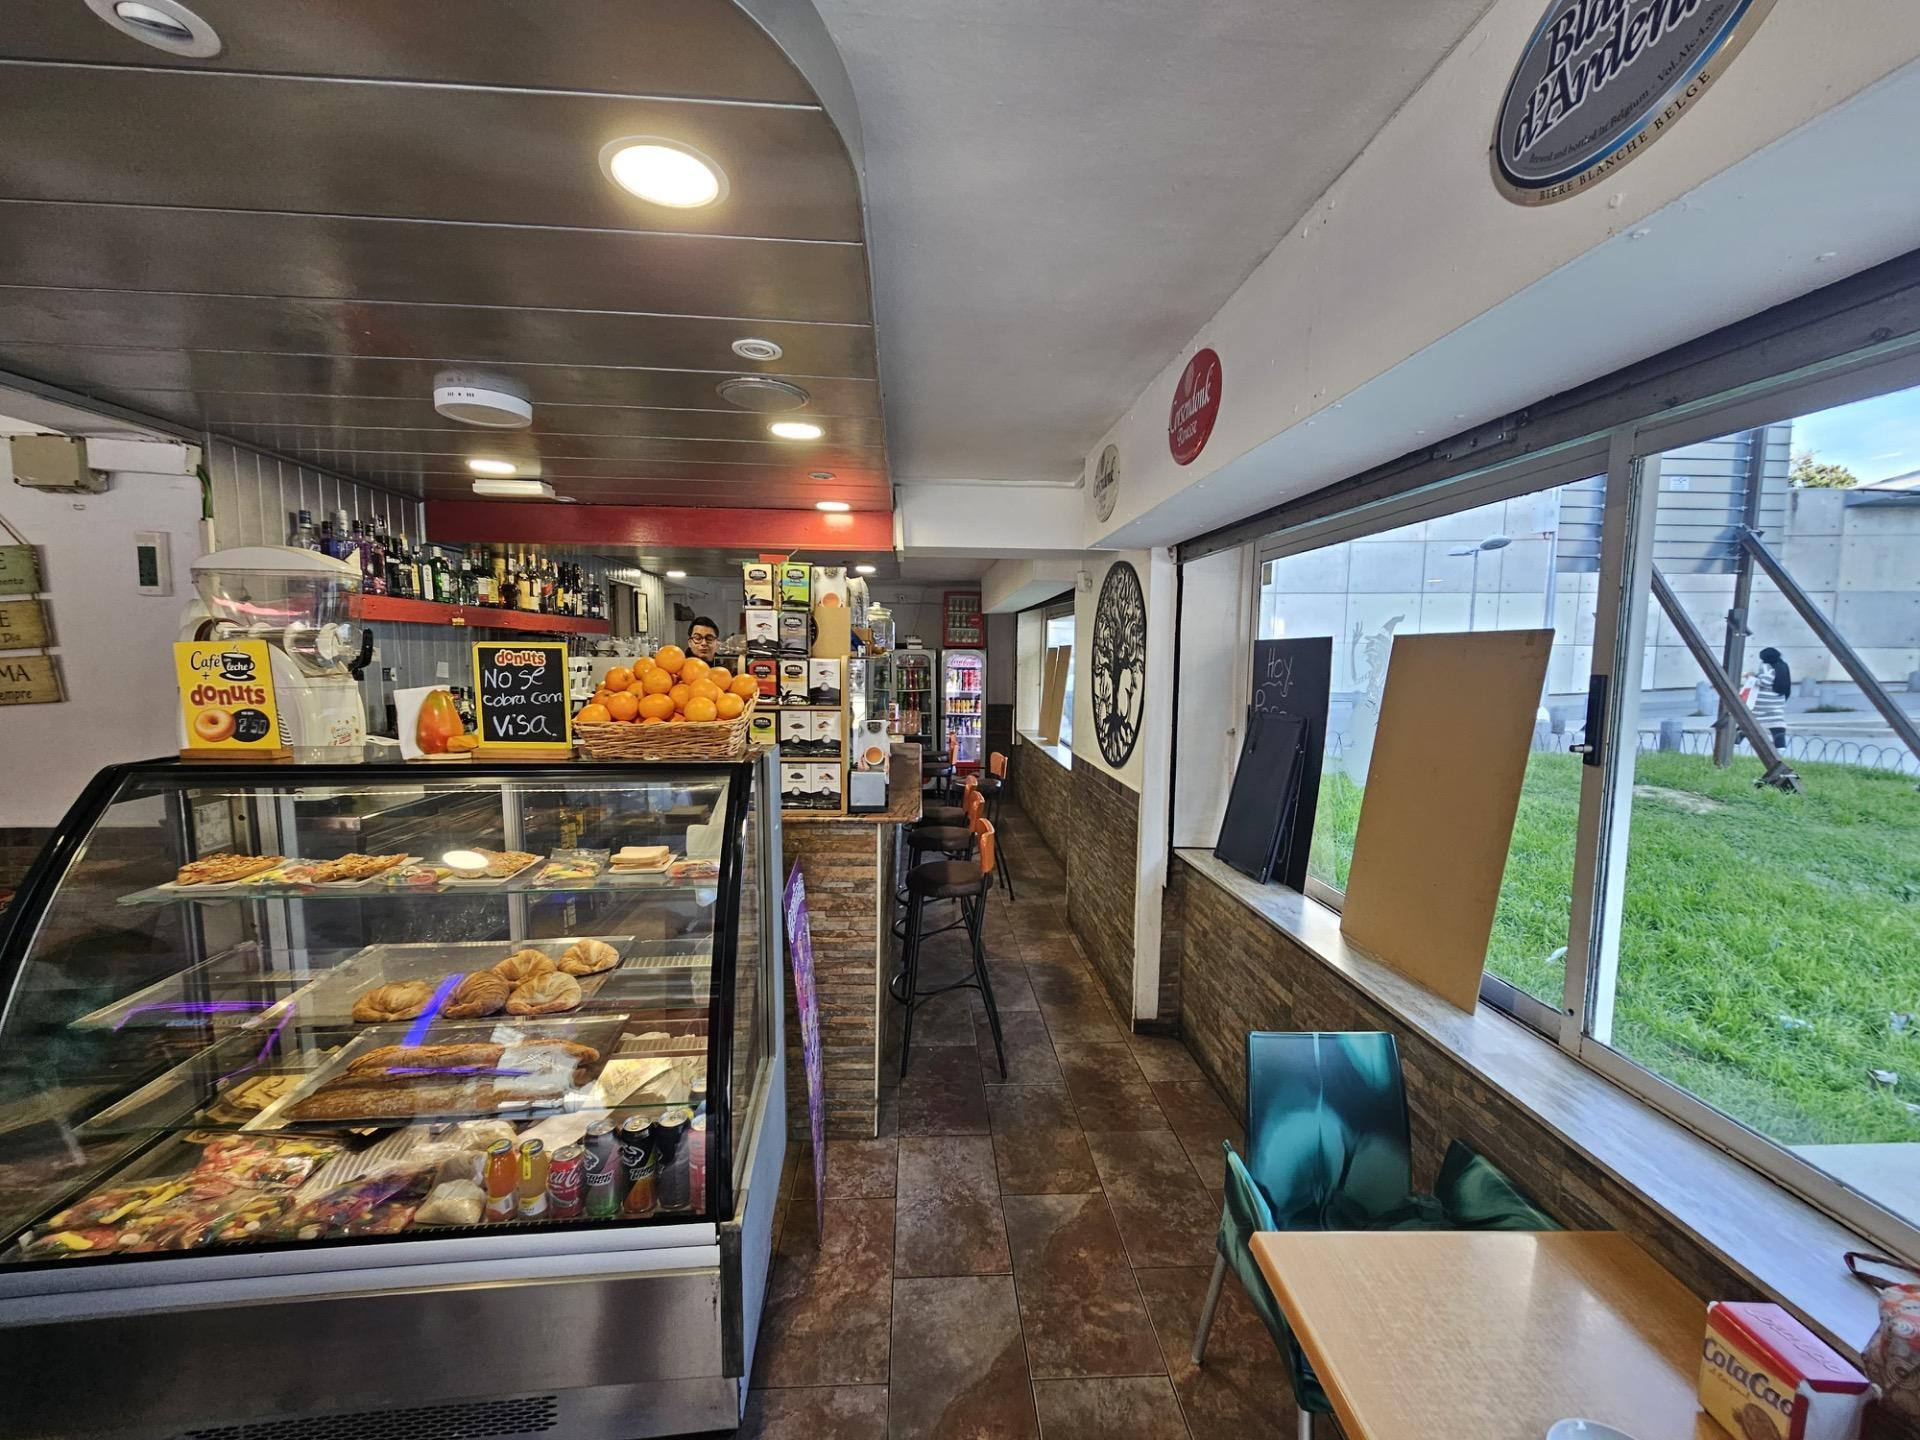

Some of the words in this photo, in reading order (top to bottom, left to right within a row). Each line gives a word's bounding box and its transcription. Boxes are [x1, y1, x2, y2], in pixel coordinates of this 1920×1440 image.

[1579, 132, 1648, 187] BLANCHE
[1653, 71, 1711, 131] BELGE
[190, 650, 221, 671] Café
[494, 648, 547, 667] donuts
[190, 684, 267, 707] donuts
